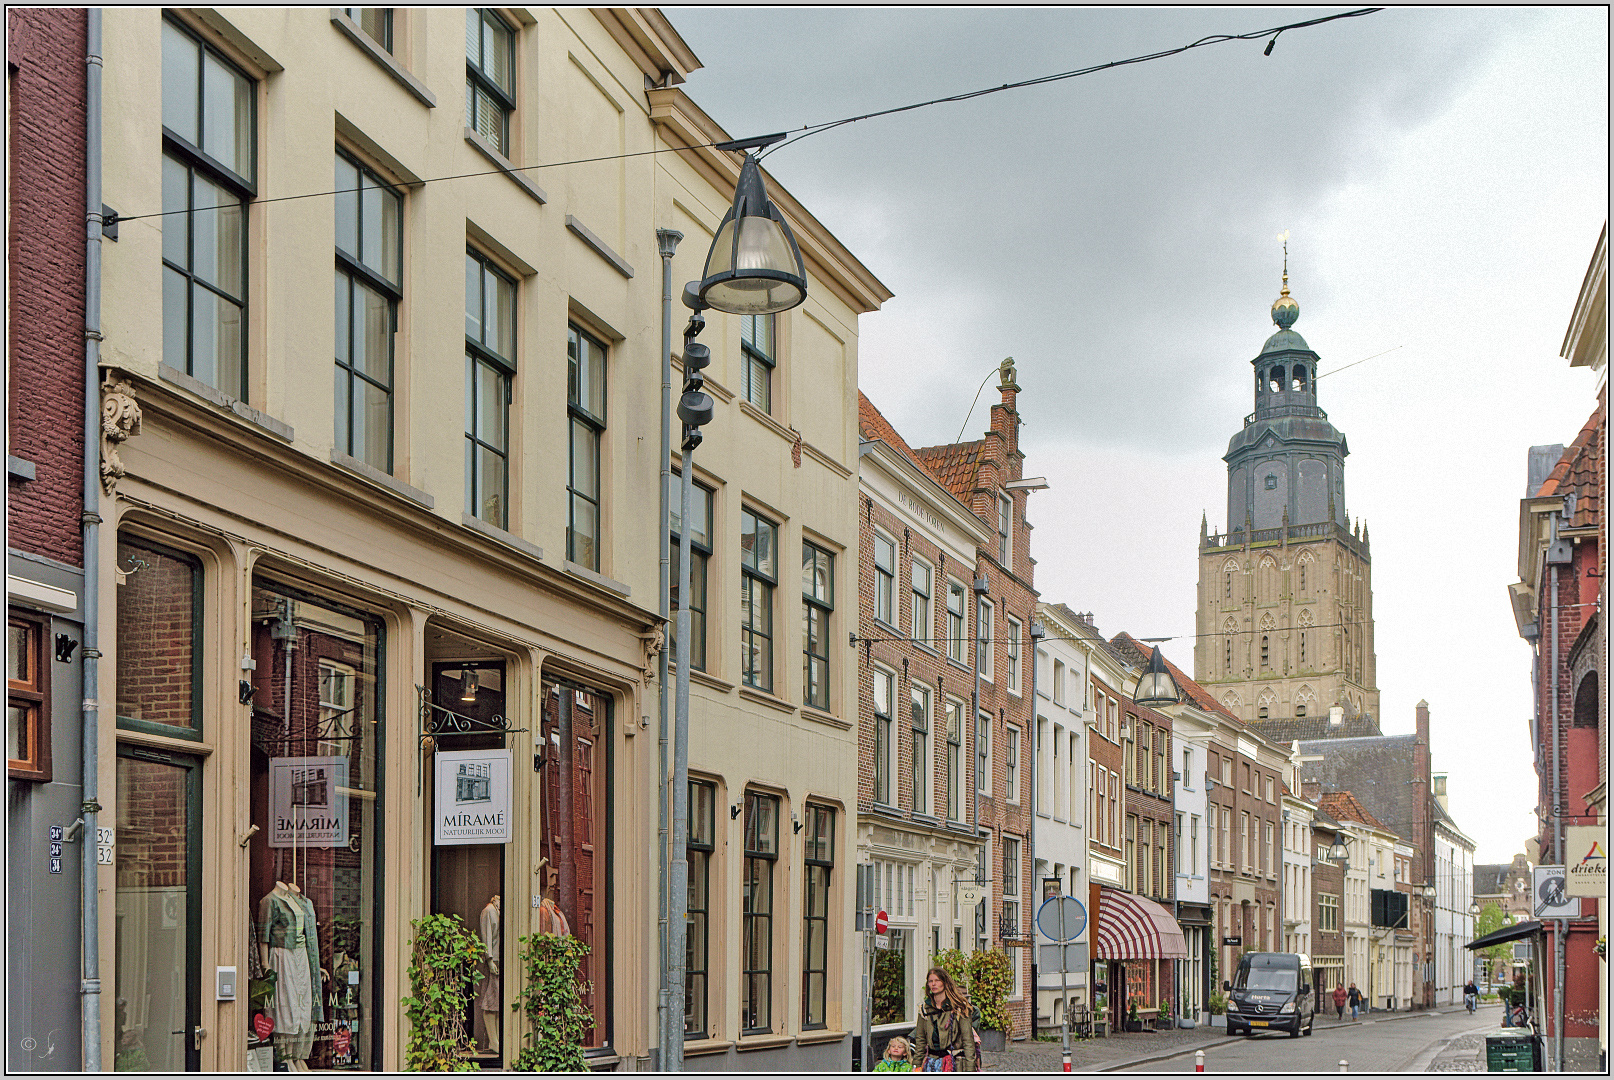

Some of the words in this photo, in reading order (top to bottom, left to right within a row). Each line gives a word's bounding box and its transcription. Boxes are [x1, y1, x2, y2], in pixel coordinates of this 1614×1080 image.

[443, 810, 505, 827] MÍRAMÉ
[443, 828, 485, 836] NATUURLIJK
[98, 847, 112, 863] 32
[52, 859, 60, 872] 34
